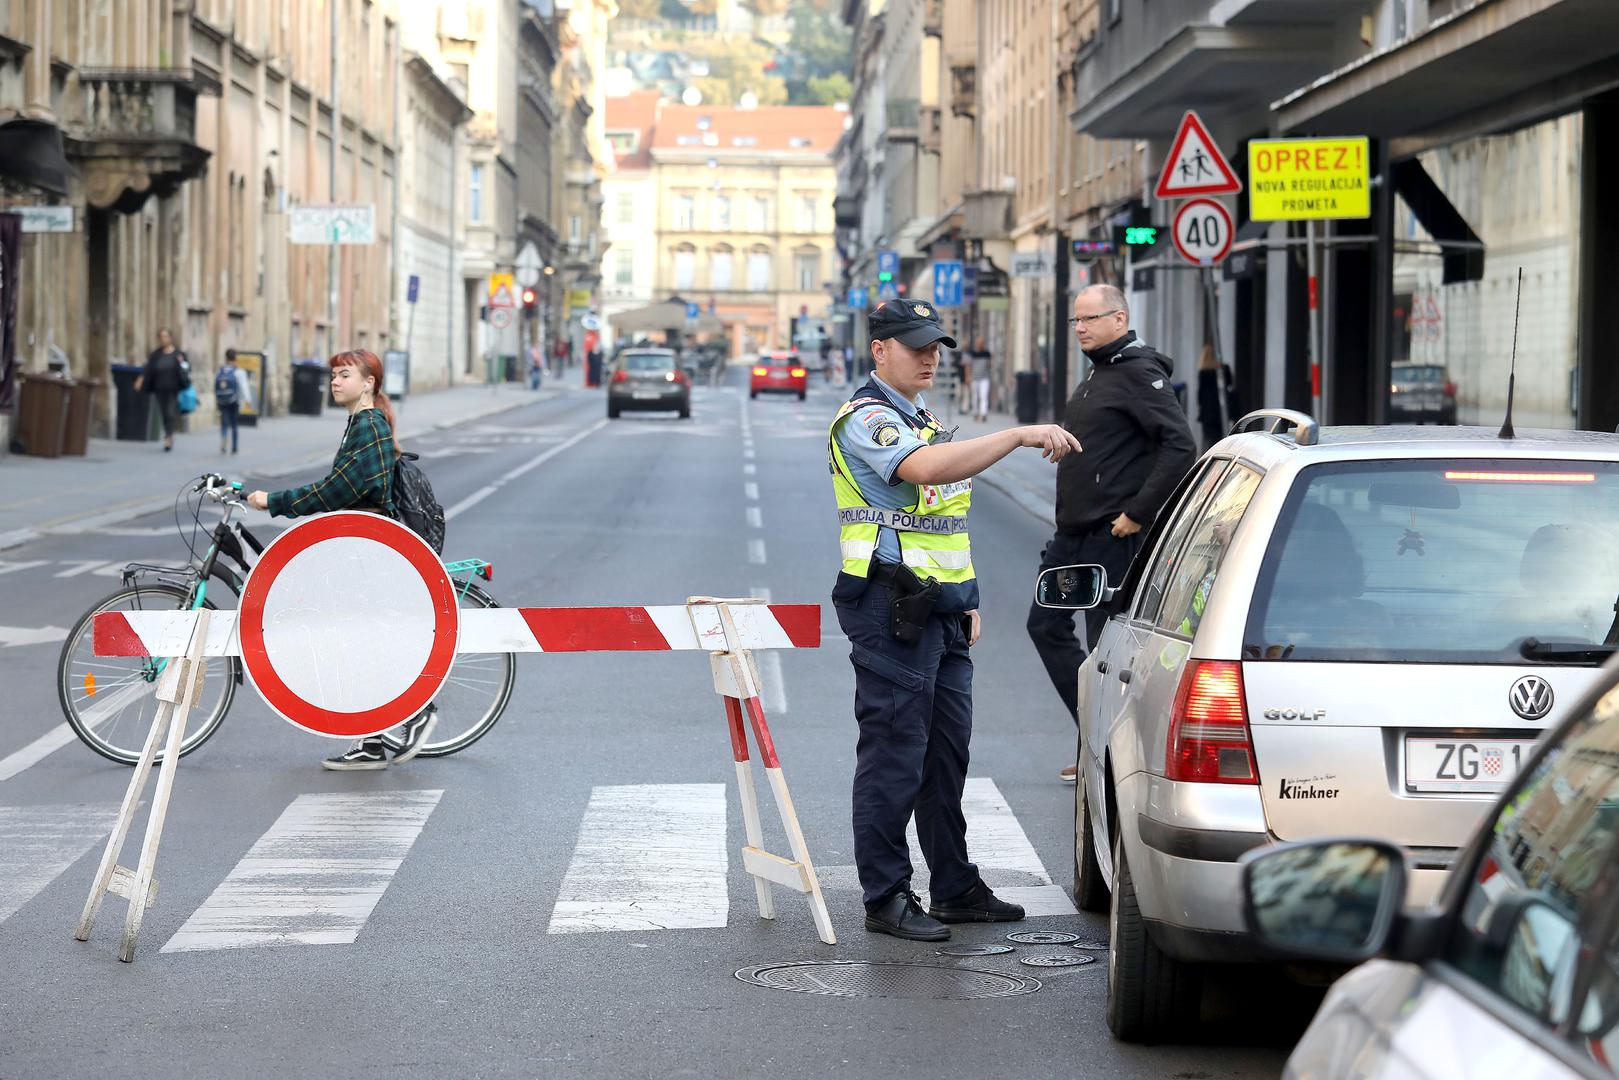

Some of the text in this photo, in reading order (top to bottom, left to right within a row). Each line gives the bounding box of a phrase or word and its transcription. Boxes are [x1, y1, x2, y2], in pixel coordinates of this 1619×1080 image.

[1256, 146, 1361, 172] OPREZ!
[1256, 178, 1362, 192] NOVA REGULACIJA
[1282, 198, 1337, 211] PROMETA
[1186, 215, 1219, 247] 40
[841, 509, 885, 523] POLICIJA
[892, 514, 949, 532] POLICIJA
[1264, 708, 1326, 721] GOLF
[1435, 744, 1479, 780] ZG
